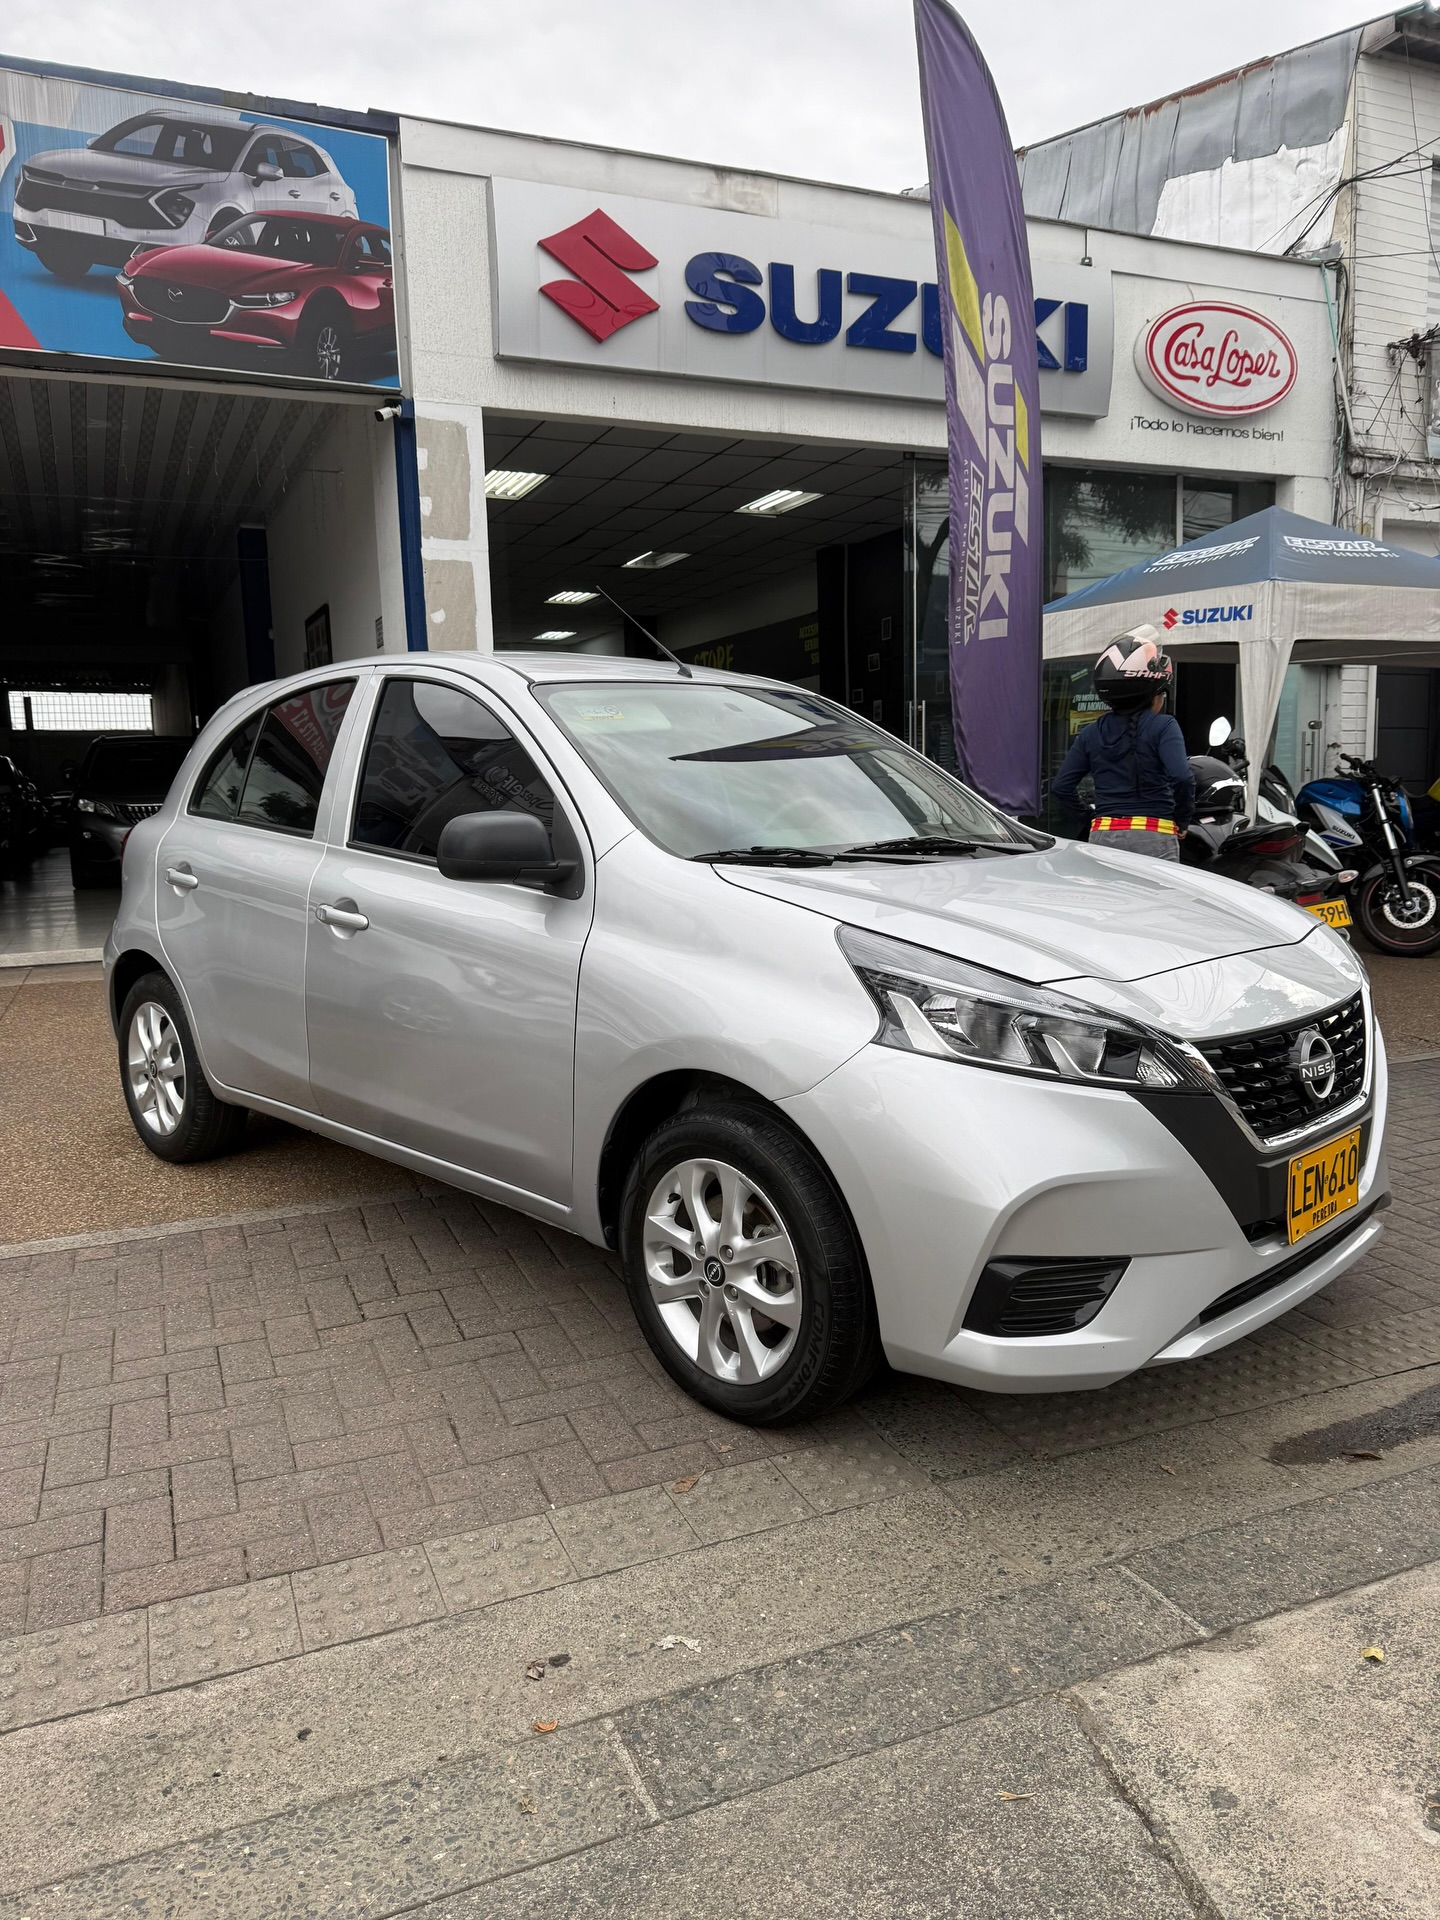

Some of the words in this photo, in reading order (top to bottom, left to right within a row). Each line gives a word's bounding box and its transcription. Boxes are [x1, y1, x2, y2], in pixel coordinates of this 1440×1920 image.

[1164, 322, 1214, 384] Casa
[1130, 416, 1169, 431] ¡Todo
[1172, 420, 1184, 432] lo
[1186, 422, 1250, 438] hacemos
[1252, 428, 1284, 441] bien!
[978, 292, 1014, 640] SUZUKI
[958, 523, 967, 583] GENUINO
[963, 460, 985, 647] ECSTAR
[1283, 535, 1390, 552] ECSTAR
[954, 597, 962, 645] SUZUKI
[1182, 604, 1253, 625] SUZUKI
[1332, 825, 1356, 839] SUZUKI
[1301, 1060, 1336, 1079] NISSA
[1312, 1200, 1338, 1226] PEREIRA
